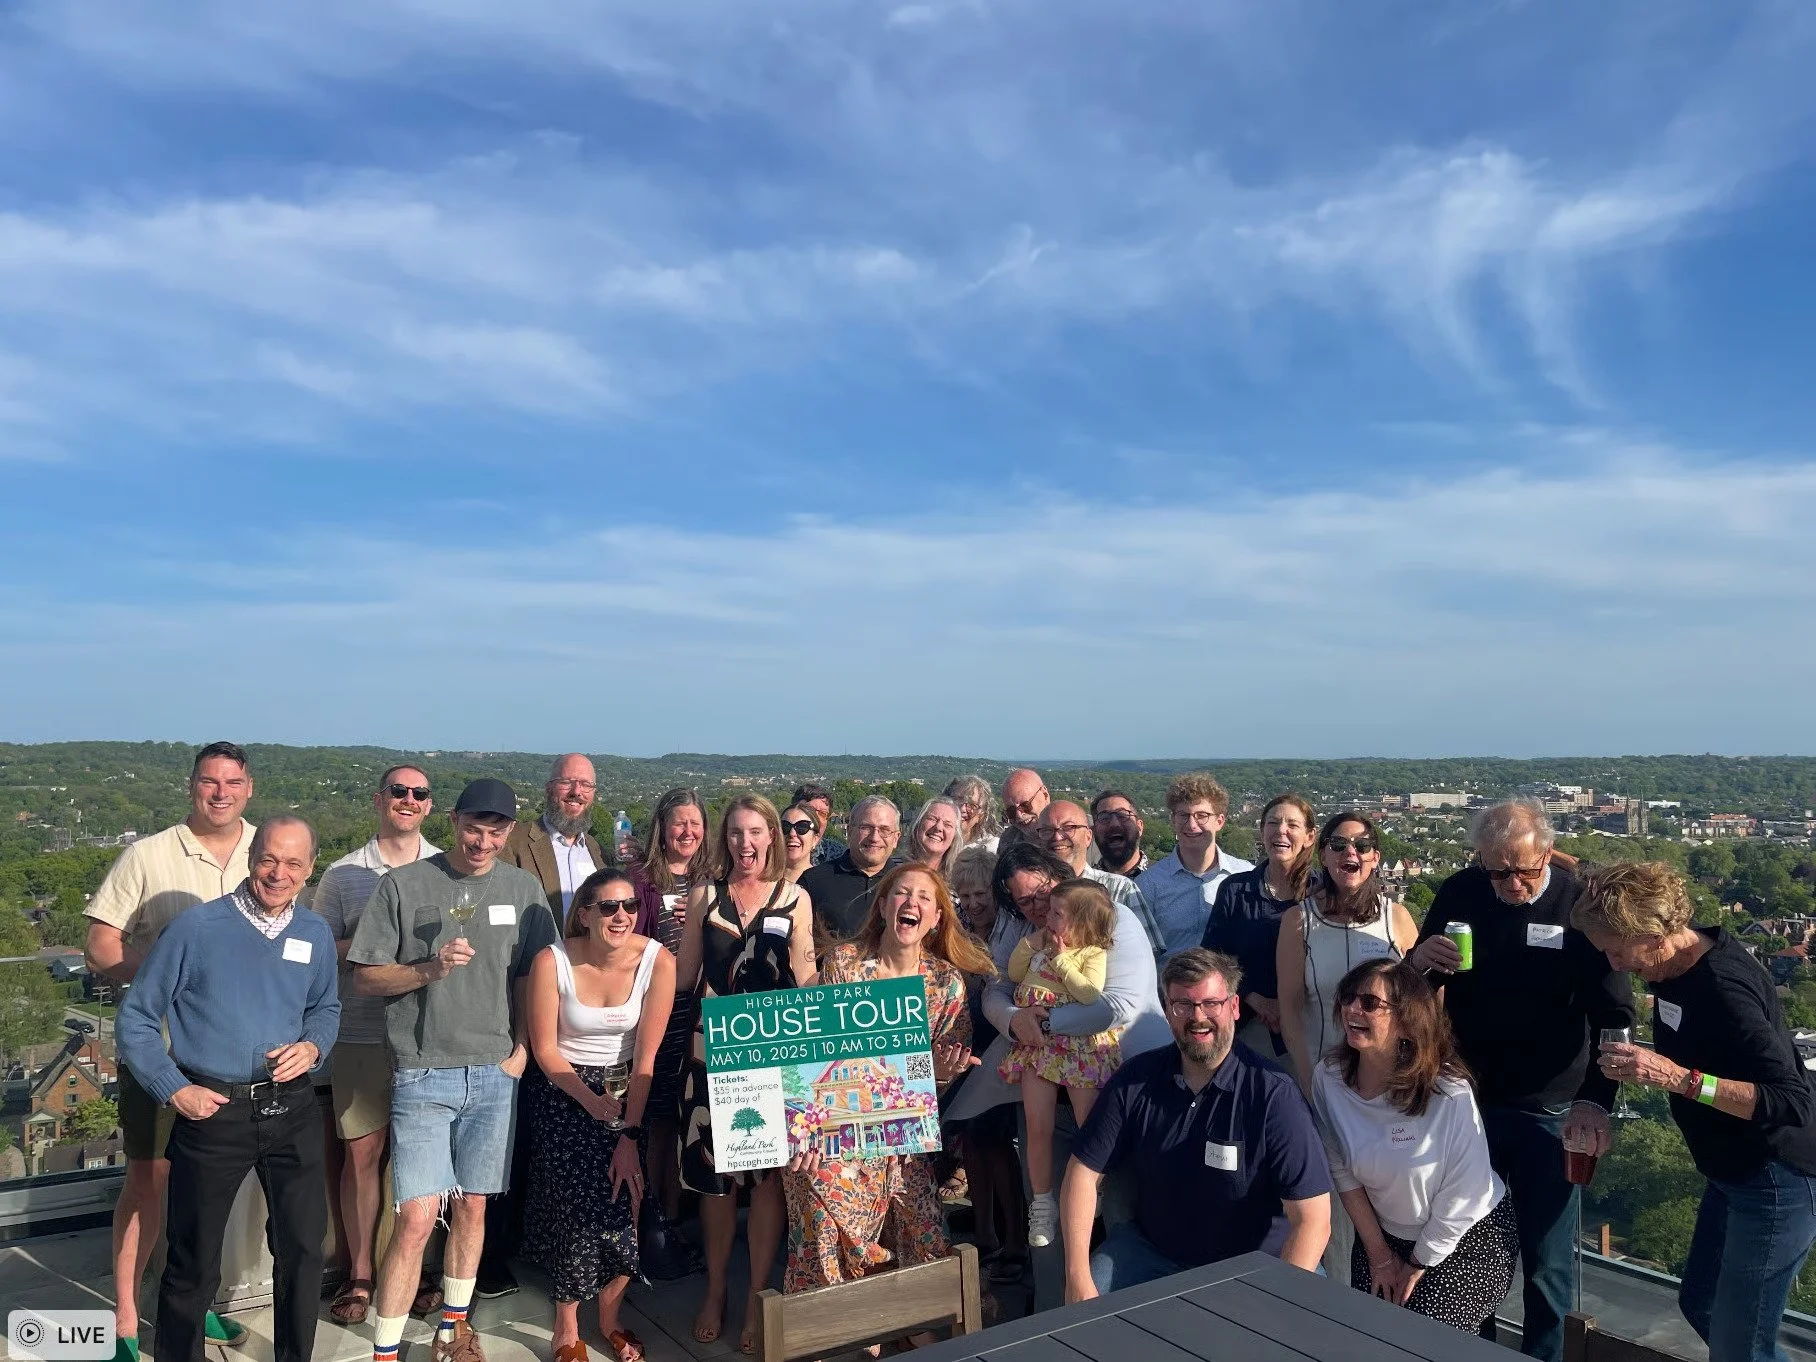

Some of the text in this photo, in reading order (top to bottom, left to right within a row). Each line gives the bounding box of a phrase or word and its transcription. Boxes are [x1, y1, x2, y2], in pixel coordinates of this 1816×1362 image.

[746, 985, 872, 1009] HIGHLAND PARK
[708, 995, 924, 1043] HOUSE TOUR
[710, 1051, 743, 1067] MAY
[748, 1049, 765, 1063] 10,
[770, 1044, 808, 1060] 2025
[821, 1041, 835, 1055] 10
[840, 1037, 863, 1052] AM
[866, 1036, 887, 1050] TO
[891, 1034, 901, 1048] 3
[905, 1032, 928, 1046] PM
[713, 1075, 748, 1085] Tickets:
[713, 1085, 730, 1095] $35
[742, 1083, 779, 1092] advance
[714, 1093, 762, 1105] $40 day of
[726, 1136, 777, 1159] Highland Park
[727, 1157, 779, 1169] hpccpgh.org
